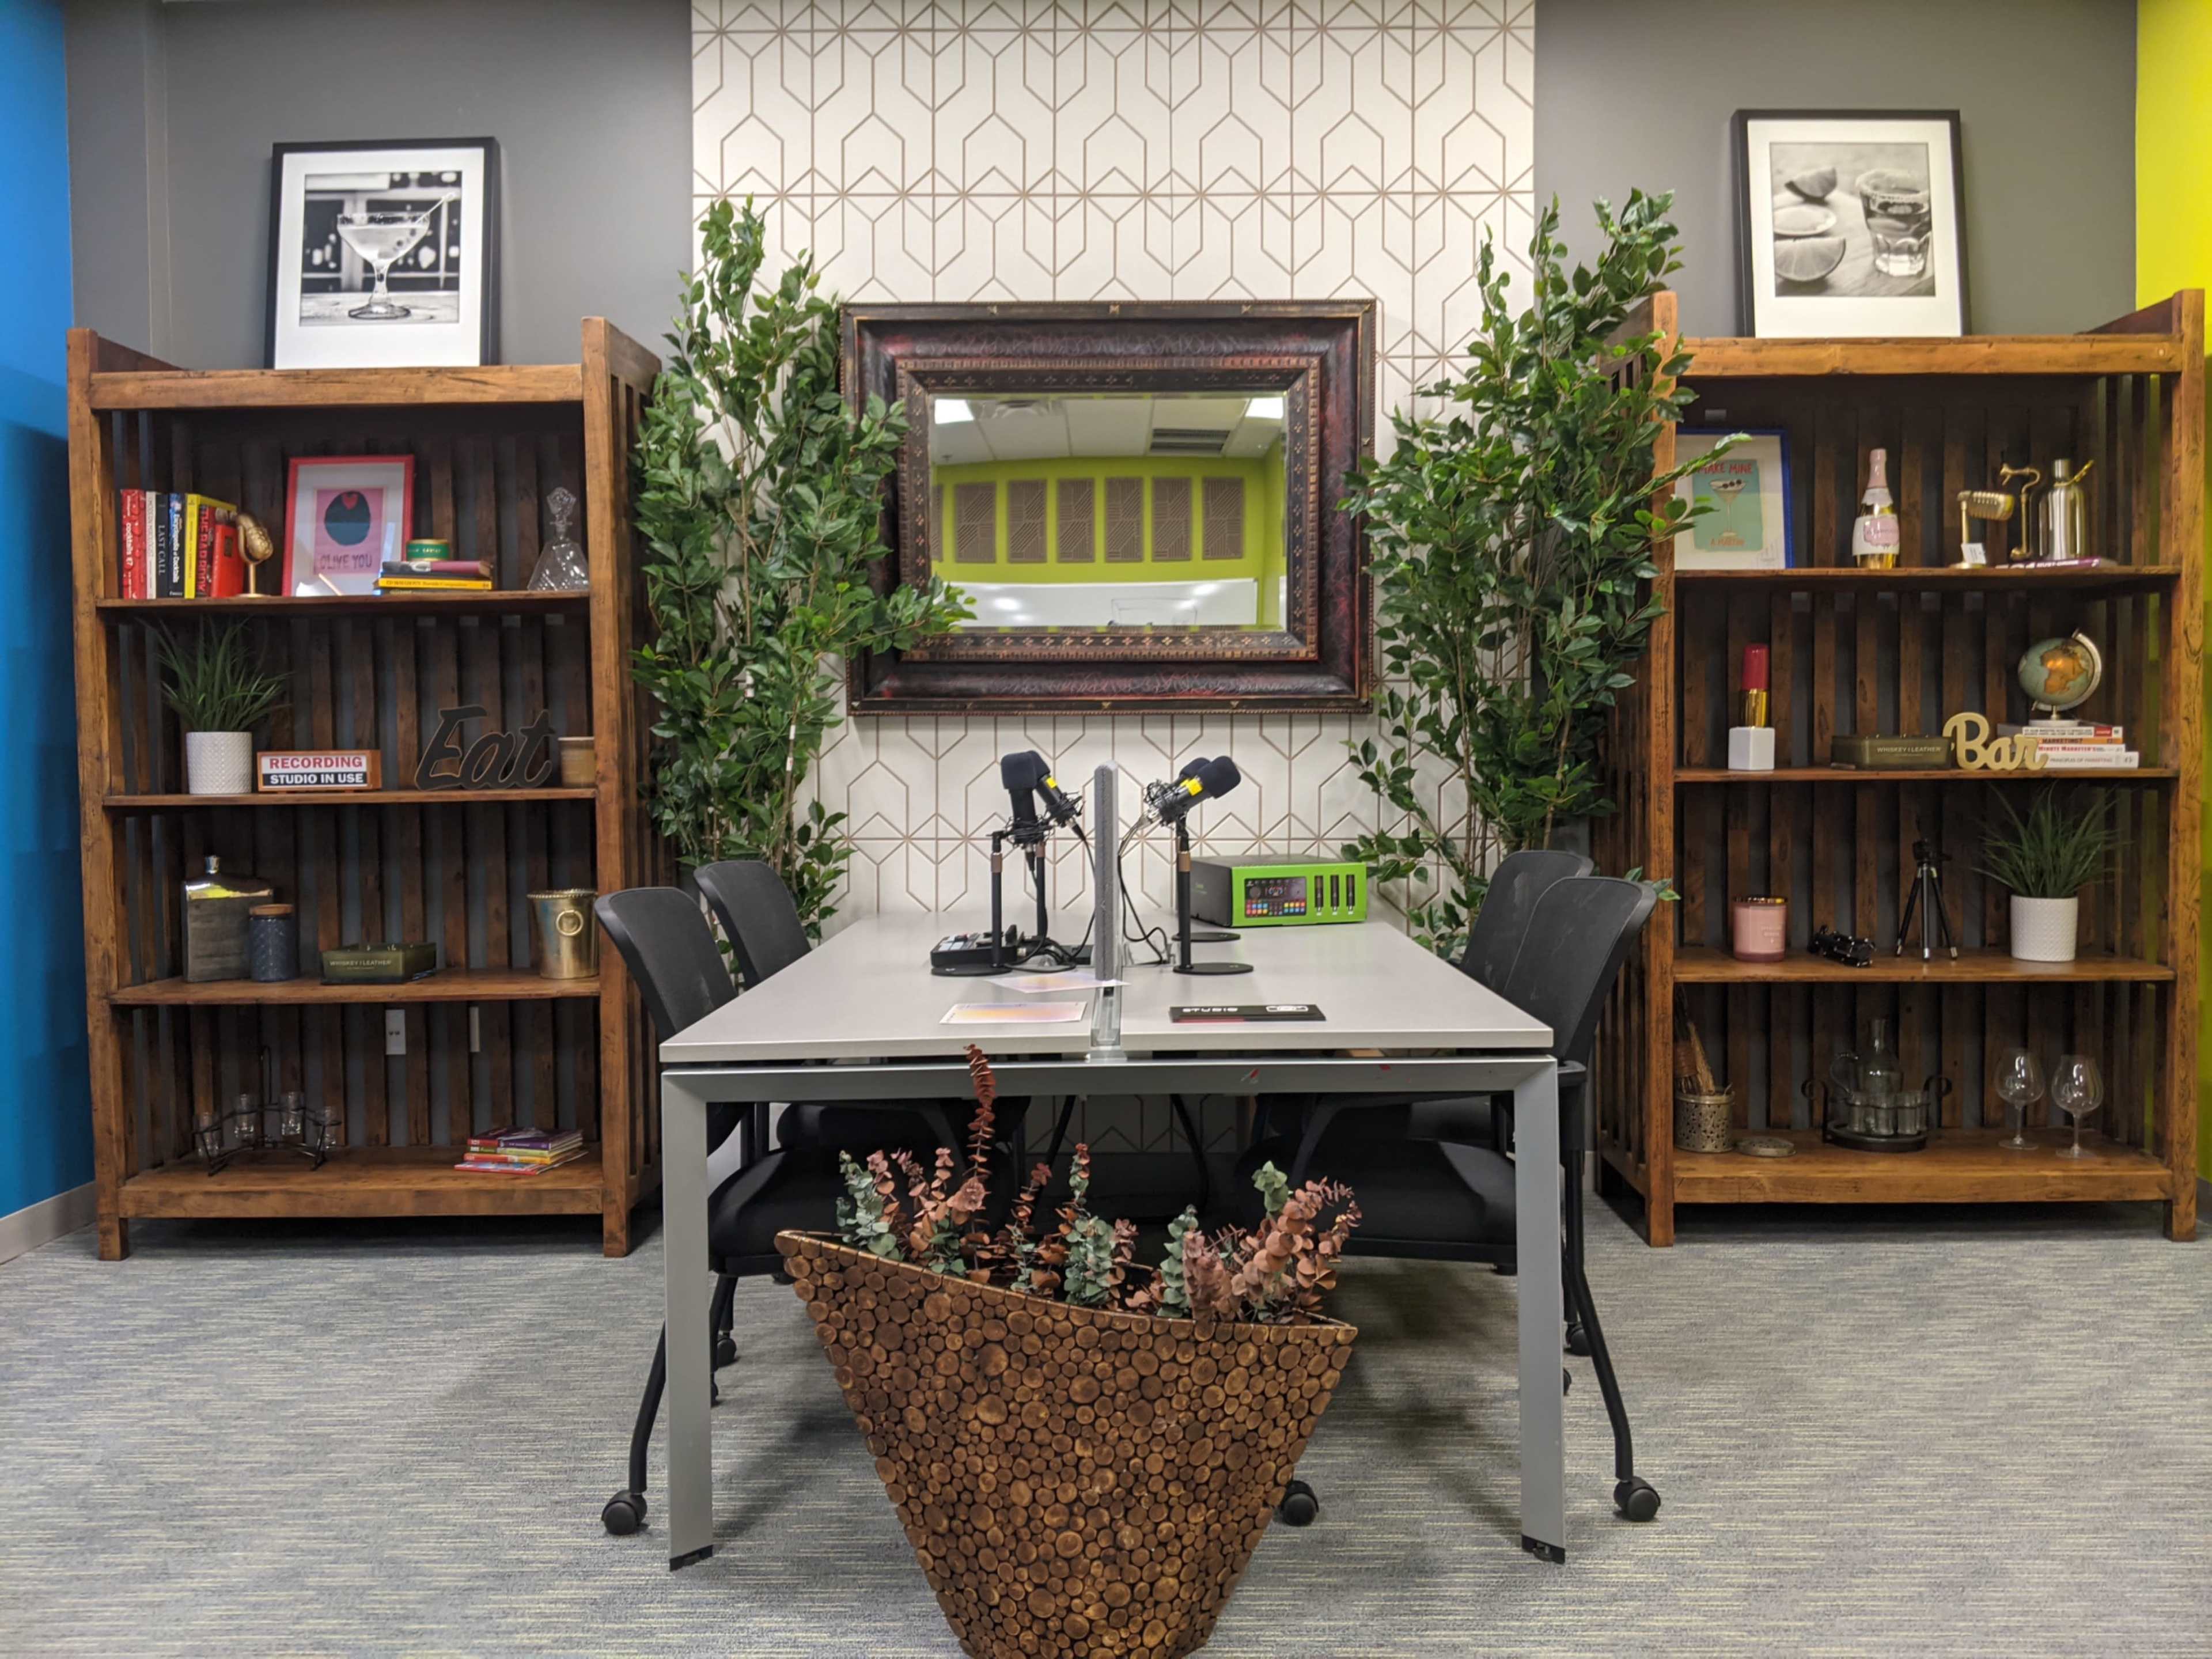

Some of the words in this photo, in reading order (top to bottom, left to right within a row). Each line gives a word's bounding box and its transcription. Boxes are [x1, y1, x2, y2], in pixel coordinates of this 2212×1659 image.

[1729, 463, 1752, 474] MINE
[352, 554, 373, 569] YOU
[415, 704, 556, 791] Eat
[1942, 712, 2049, 771] Bar
[270, 756, 362, 769] RECORDING
[270, 774, 317, 784] STUDIO
[321, 774, 334, 784] IN
[338, 773, 363, 783] USE
